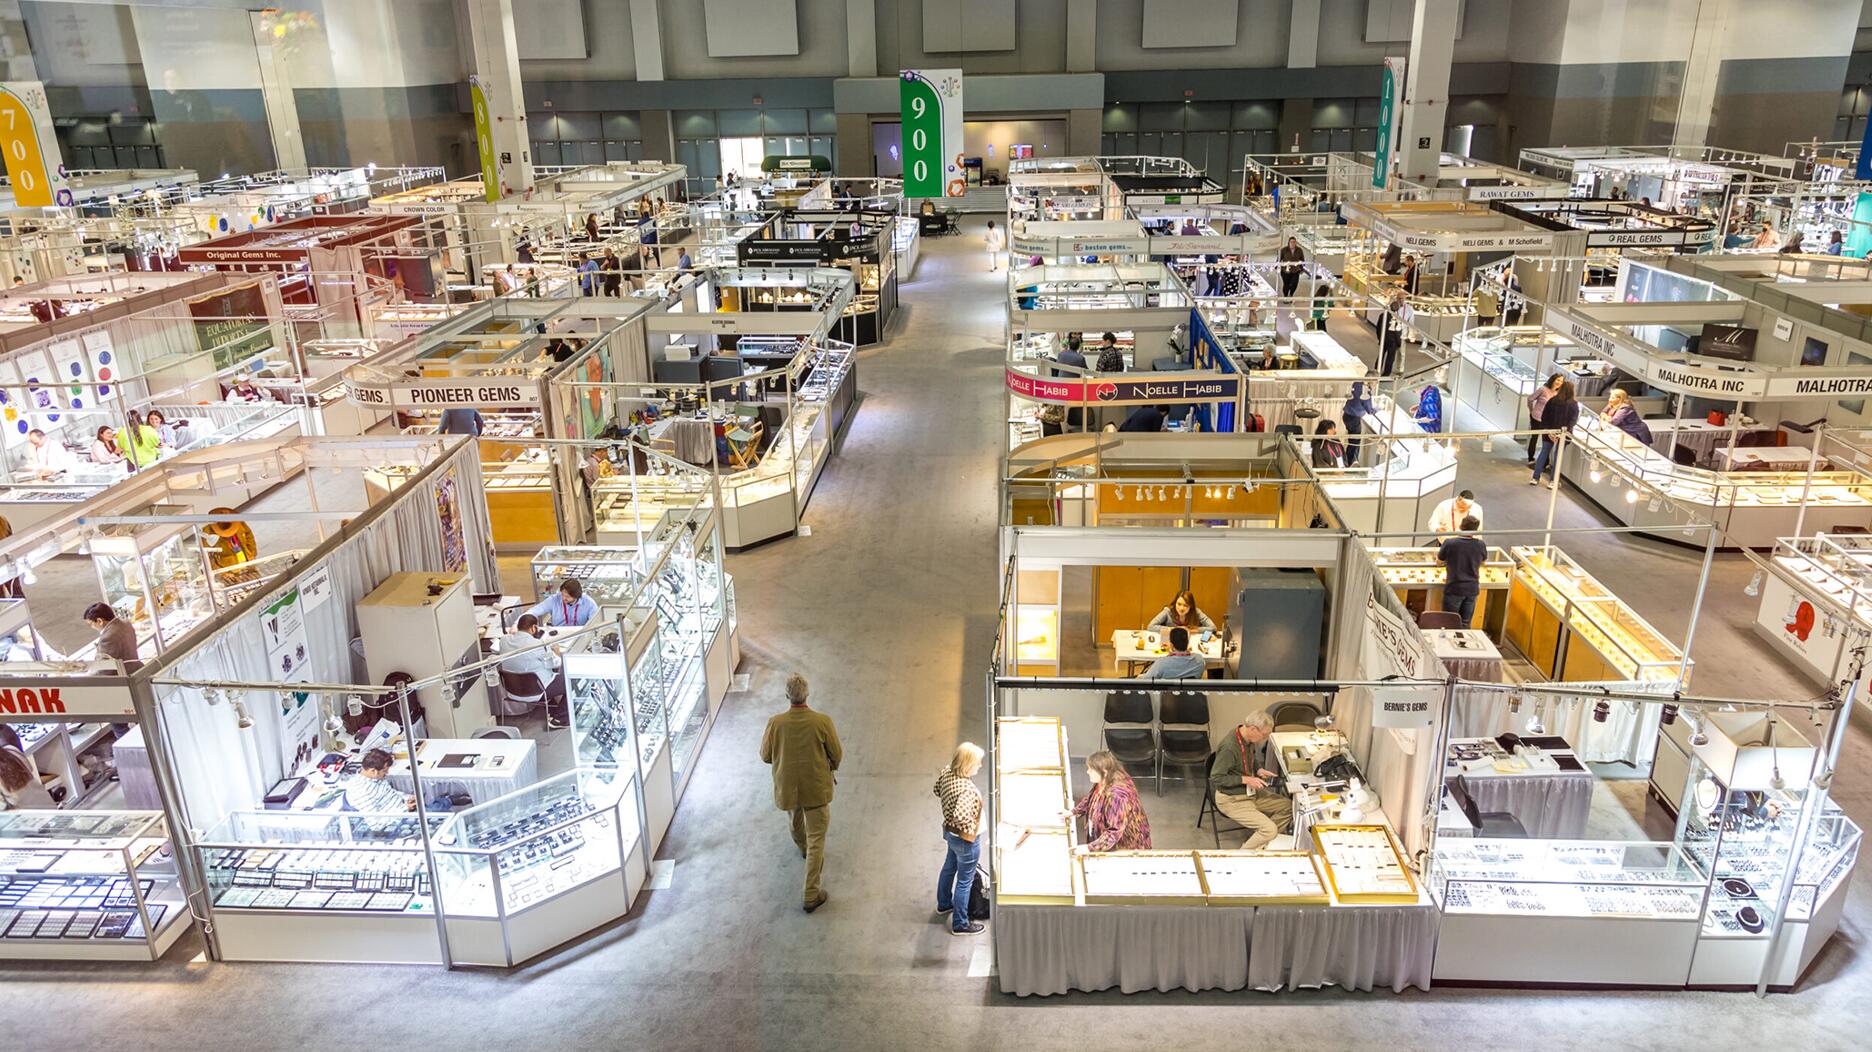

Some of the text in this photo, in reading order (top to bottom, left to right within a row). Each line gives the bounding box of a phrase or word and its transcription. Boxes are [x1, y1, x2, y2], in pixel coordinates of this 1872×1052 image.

[1377, 78, 1391, 180] 1000
[477, 102, 493, 186] 800
[911, 97, 928, 182] 900
[2, 109, 34, 190] 700
[1480, 190, 1535, 198] RAWAT GEMS
[1418, 238, 1437, 247] GEMS
[1477, 239, 1494, 247] GEMS
[1508, 238, 1515, 246] M
[1515, 238, 1543, 246] Schofield
[1616, 235, 1663, 244] REAL GEMS
[206, 251, 281, 261] Original Gems Inc.
[1571, 323, 1616, 357] MALHOTRA INC
[1007, 371, 1068, 397] NOELLE HABIB
[1657, 368, 1745, 392] MALHOTRA INC
[1796, 379, 1872, 393] MALHOTRA
[354, 388, 384, 403] GEMS
[411, 388, 474, 403] PIONEER
[478, 387, 521, 402] GEMS
[1133, 382, 1223, 399] NOELLE HABIB
[0, 688, 66, 714] NAK
[1384, 702, 1428, 712] BERNIE'S GEMS
